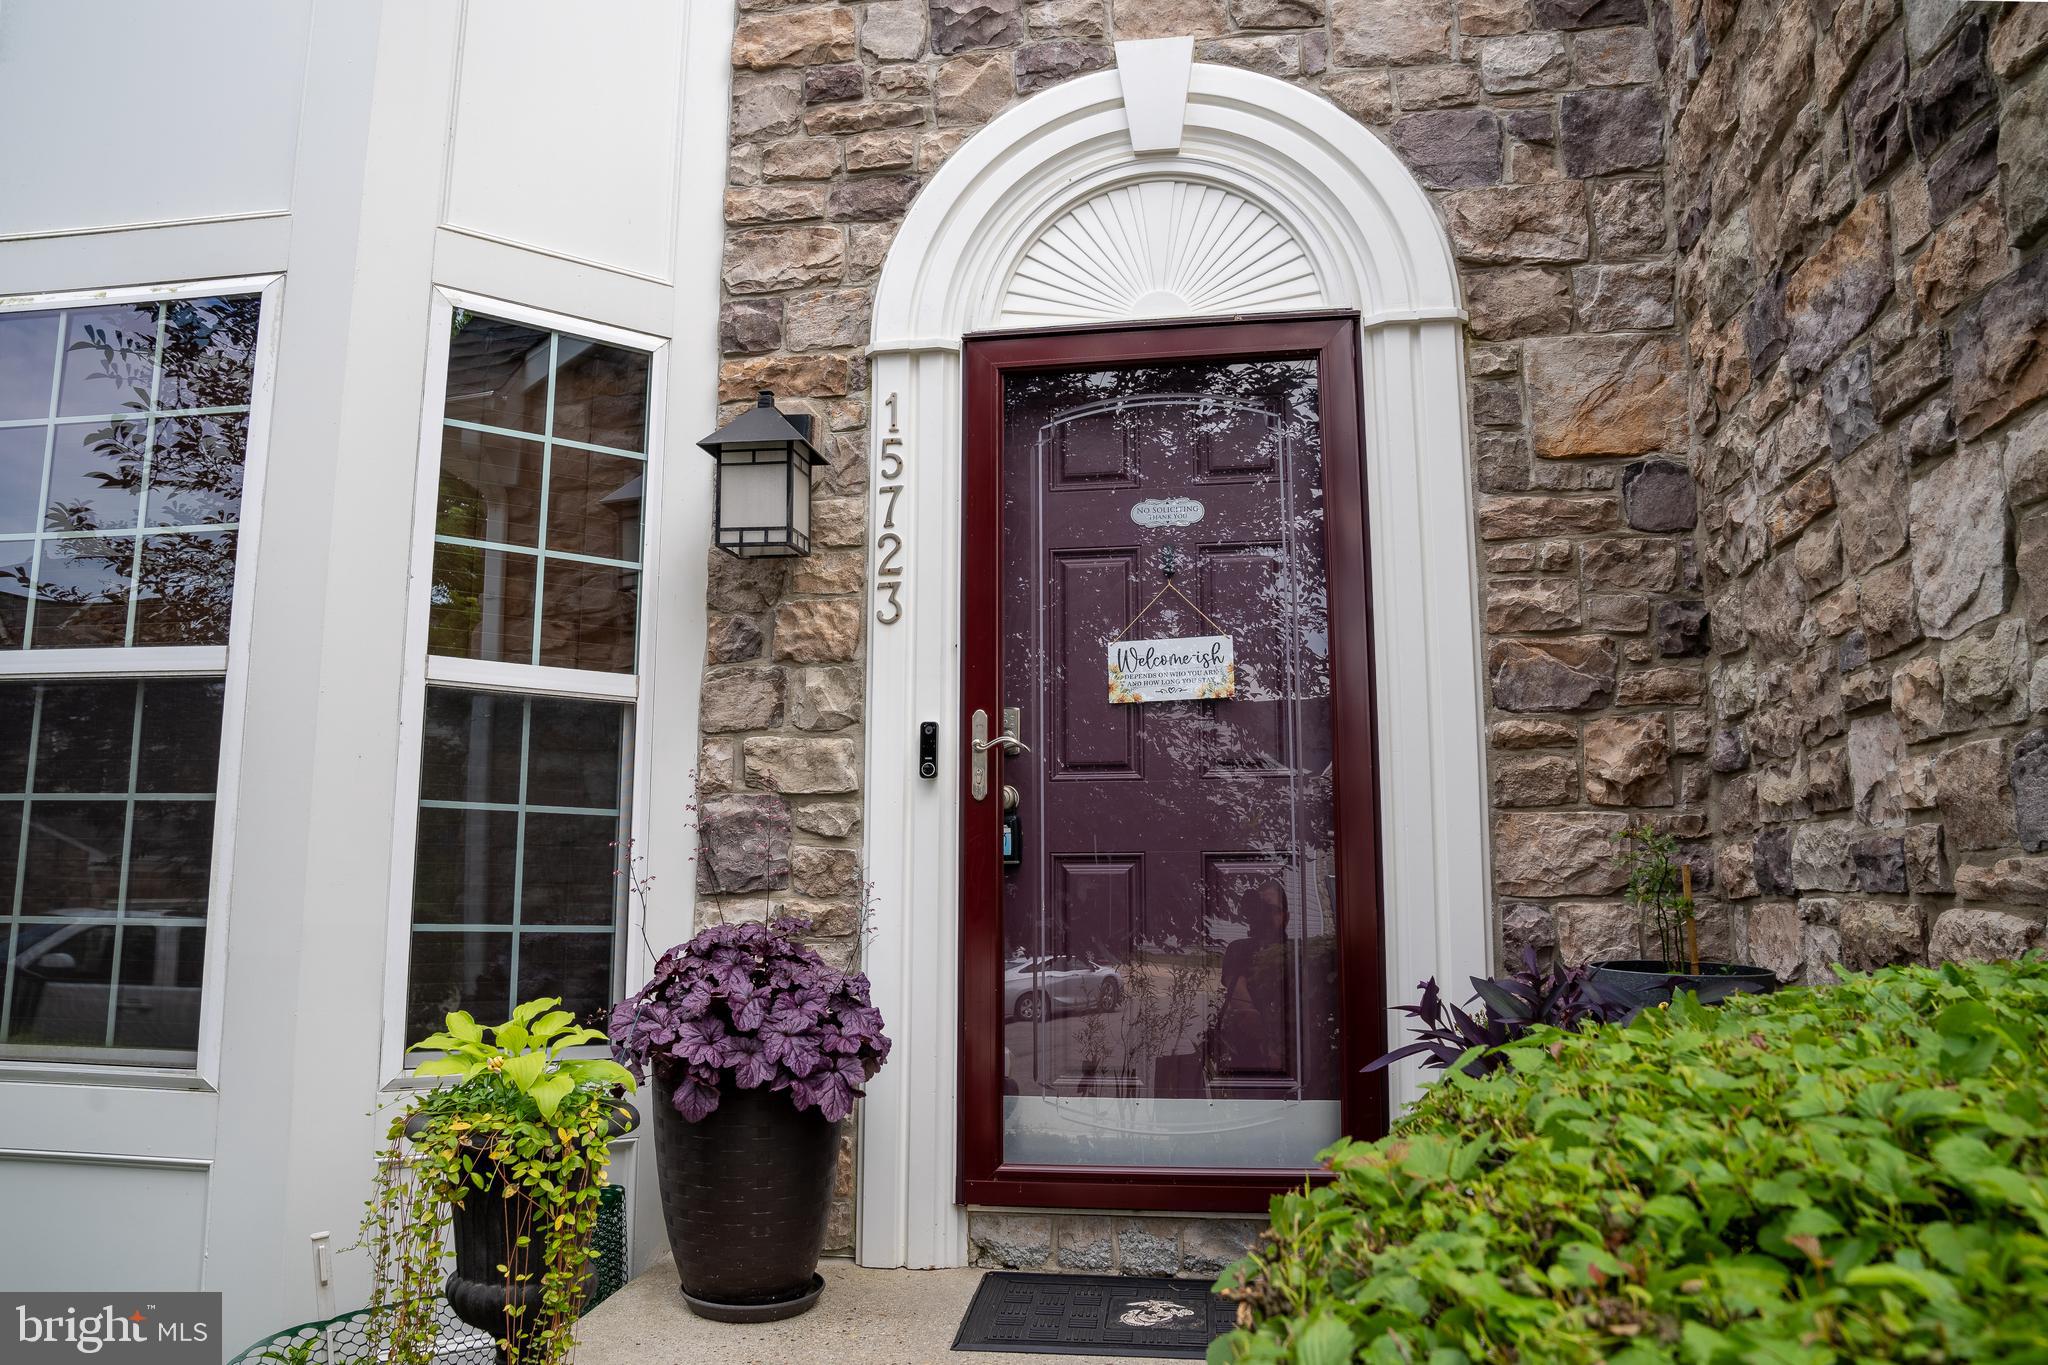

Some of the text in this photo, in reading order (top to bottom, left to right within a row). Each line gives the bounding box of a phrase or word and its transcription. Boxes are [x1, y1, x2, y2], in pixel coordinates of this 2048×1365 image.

[876, 392, 904, 625] 15723
[1137, 505, 1199, 515] NO SOLICITING
[1124, 672, 1157, 680] DEPENDS
